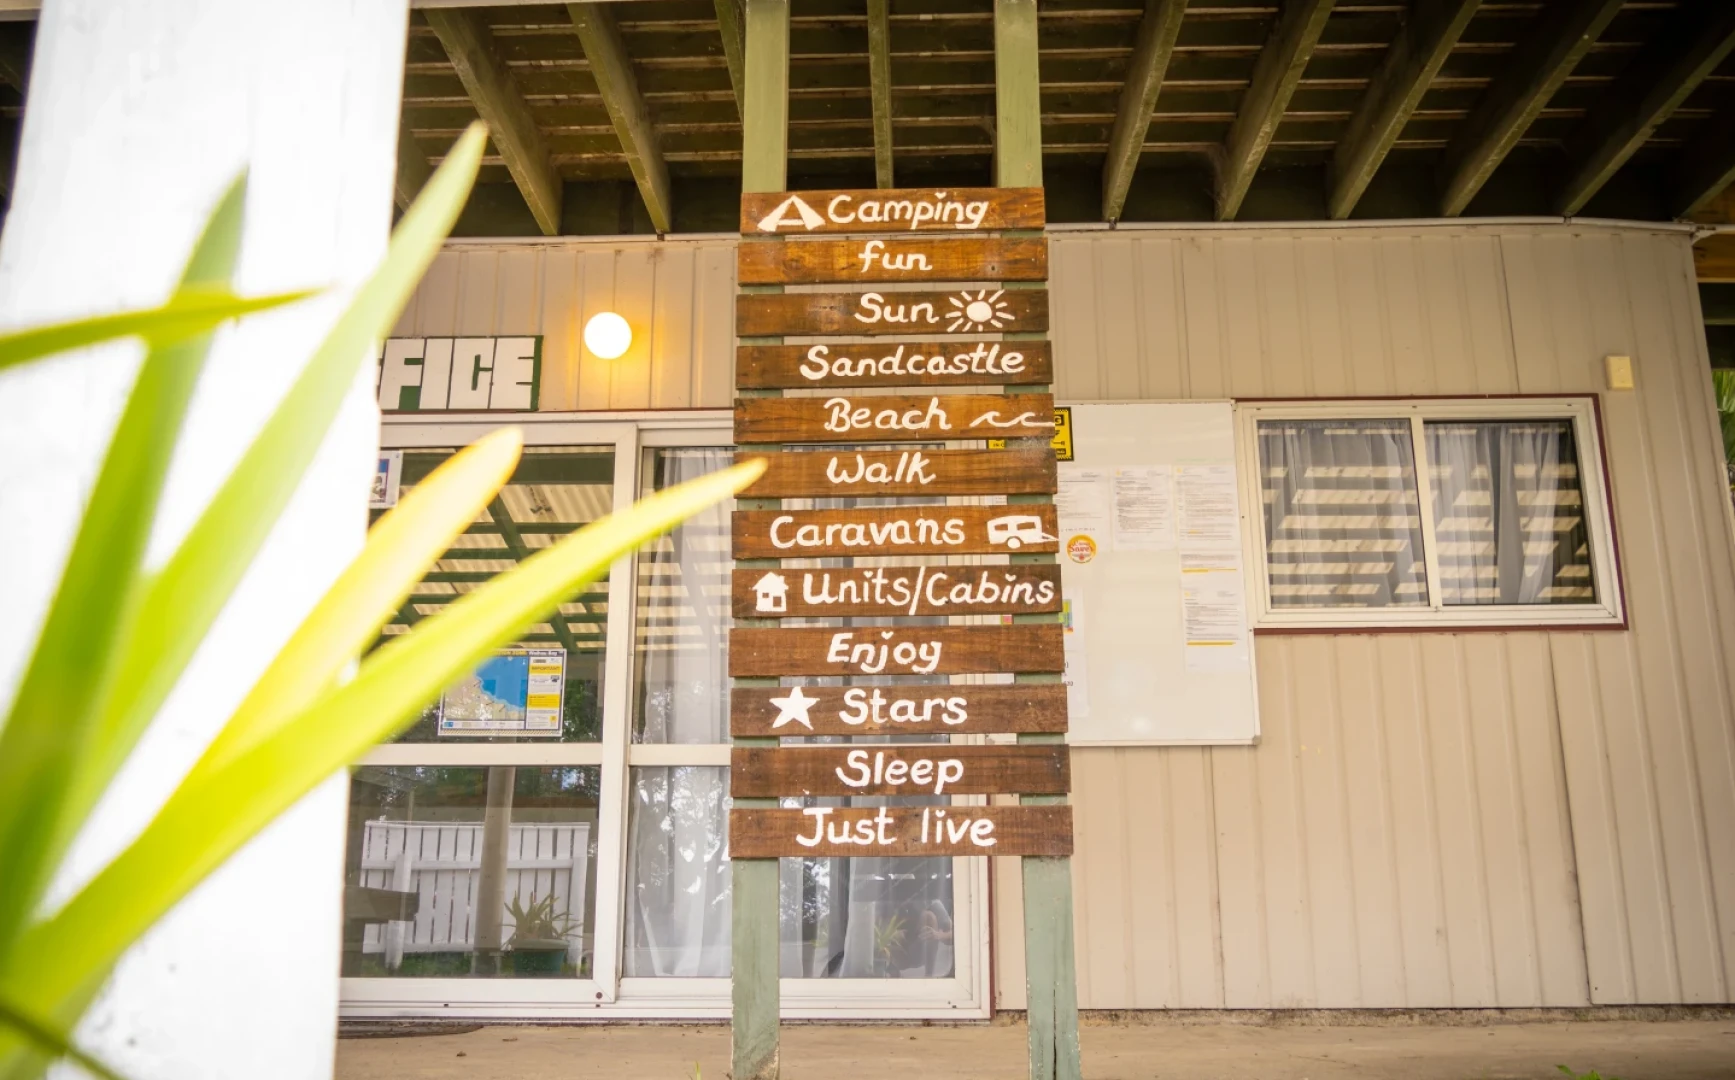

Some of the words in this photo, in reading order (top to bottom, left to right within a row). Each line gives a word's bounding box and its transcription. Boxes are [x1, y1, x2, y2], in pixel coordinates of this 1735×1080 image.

[828, 192, 989, 230] Camping
[858, 240, 933, 273] fun
[854, 292, 939, 324] Sun
[377, 338, 536, 410] FICE
[799, 343, 1025, 380] Sandcastle
[824, 397, 952, 432] Beach
[826, 452, 936, 484] Walk
[769, 515, 965, 549] Caravans
[803, 565, 1055, 616] Units/Cabins
[826, 631, 942, 674] Enjoy
[838, 687, 968, 726] Stars
[835, 750, 964, 795] Sleep
[796, 806, 898, 848] Just
[920, 807, 997, 847] live
